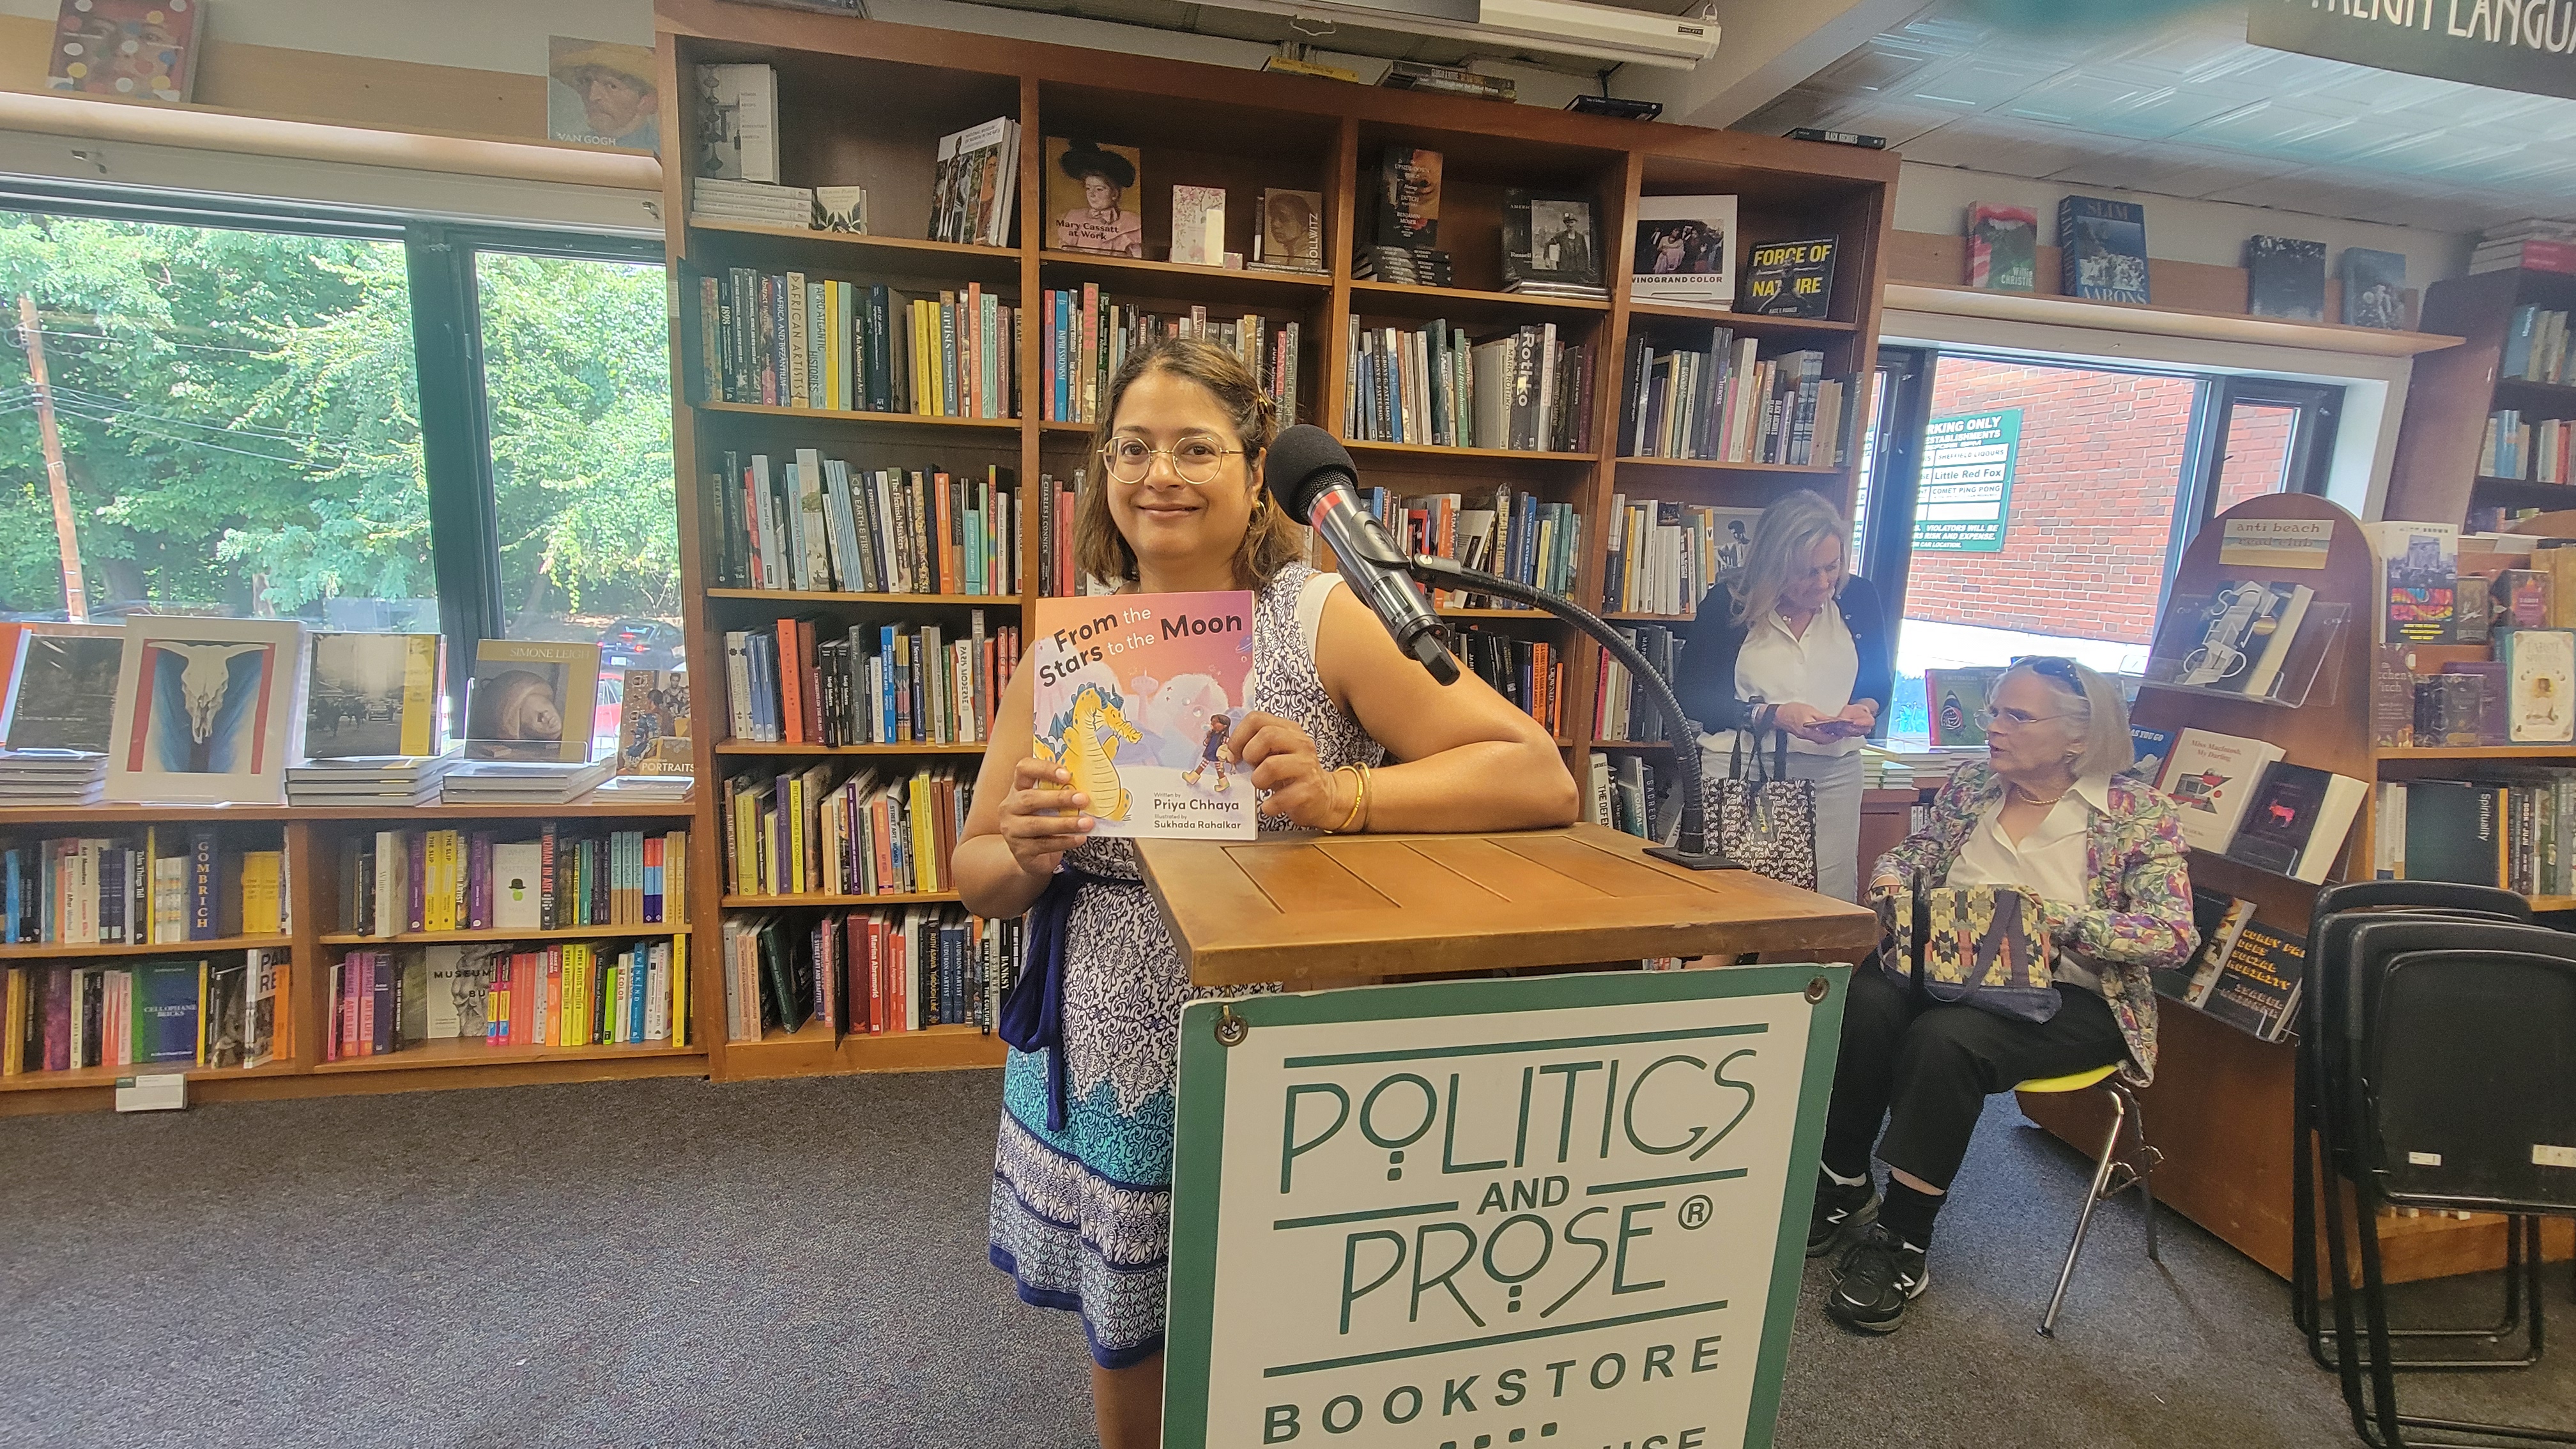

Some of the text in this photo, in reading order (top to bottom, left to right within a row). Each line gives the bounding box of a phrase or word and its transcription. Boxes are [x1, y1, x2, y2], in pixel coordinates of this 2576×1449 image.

[557, 133, 616, 147] VAN GOGH
[1056, 219, 1119, 233] Mary Cassatt
[1082, 230, 1107, 240] Work
[1310, 213, 1318, 266] KOLLWITZ
[1753, 245, 1832, 267] FORCE OF
[2001, 275, 2033, 287] CHRISTIE
[2083, 286, 2147, 304] AARONS
[721, 305, 730, 325] 1898
[1084, 287, 1097, 350] GIANTS
[791, 284, 804, 388] AFRICAN ARTISTS
[778, 342, 786, 386] BYZANTIUM
[1057, 330, 1066, 380] IMPRESSIONISM
[1286, 354, 1294, 384] Camille
[1517, 332, 1535, 407] Rothko
[809, 351, 818, 392] HISTORIES
[1630, 337, 1644, 422] Photography Monograph
[1925, 430, 2001, 445] ESTABLISHMENTS
[1928, 417, 2002, 435] RKING ONLY
[1935, 471, 1959, 480] Little
[1962, 470, 1981, 479] Red
[1984, 469, 2001, 477] Fox
[868, 489, 877, 531] EXPRESSIONISTS
[892, 477, 905, 549] The Flemish Masters
[854, 500, 863, 526] EARTH
[860, 535, 869, 554] FIRE
[2237, 523, 2320, 533] anti beach
[2238, 537, 2313, 548] read club
[1054, 608, 1151, 653] From the
[510, 649, 590, 661] SIMONE LEIGH
[1039, 614, 1242, 687] Stars to the Moon
[641, 765, 694, 774] PORTRAITS
[2196, 749, 2232, 763] My Darling
[1154, 799, 1239, 812] Priya Chhaya
[1598, 785, 1609, 827] THE DEFEN
[1646, 779, 1656, 820] SACRED
[1154, 820, 1241, 829] Sukhada Rahalkar
[2478, 793, 2492, 841] Spirituality
[542, 834, 553, 864] WOMAN
[135, 851, 144, 898] Tales Things Tell
[196, 841, 210, 928] GOMBRICH
[542, 878, 553, 892] ART
[434, 970, 491, 979] MUSEUM
[1000, 955, 1009, 990] BANKSY
[144, 1005, 197, 1014] CELLOPHANE
[345, 1023, 353, 1038] LIFE
[1281, 1048, 1758, 1195] POLITICS
[1476, 1174, 1571, 1216] AND
[1338, 1200, 1667, 1336] PROSE
[1262, 1334, 1723, 1447] BOOKSTORE
